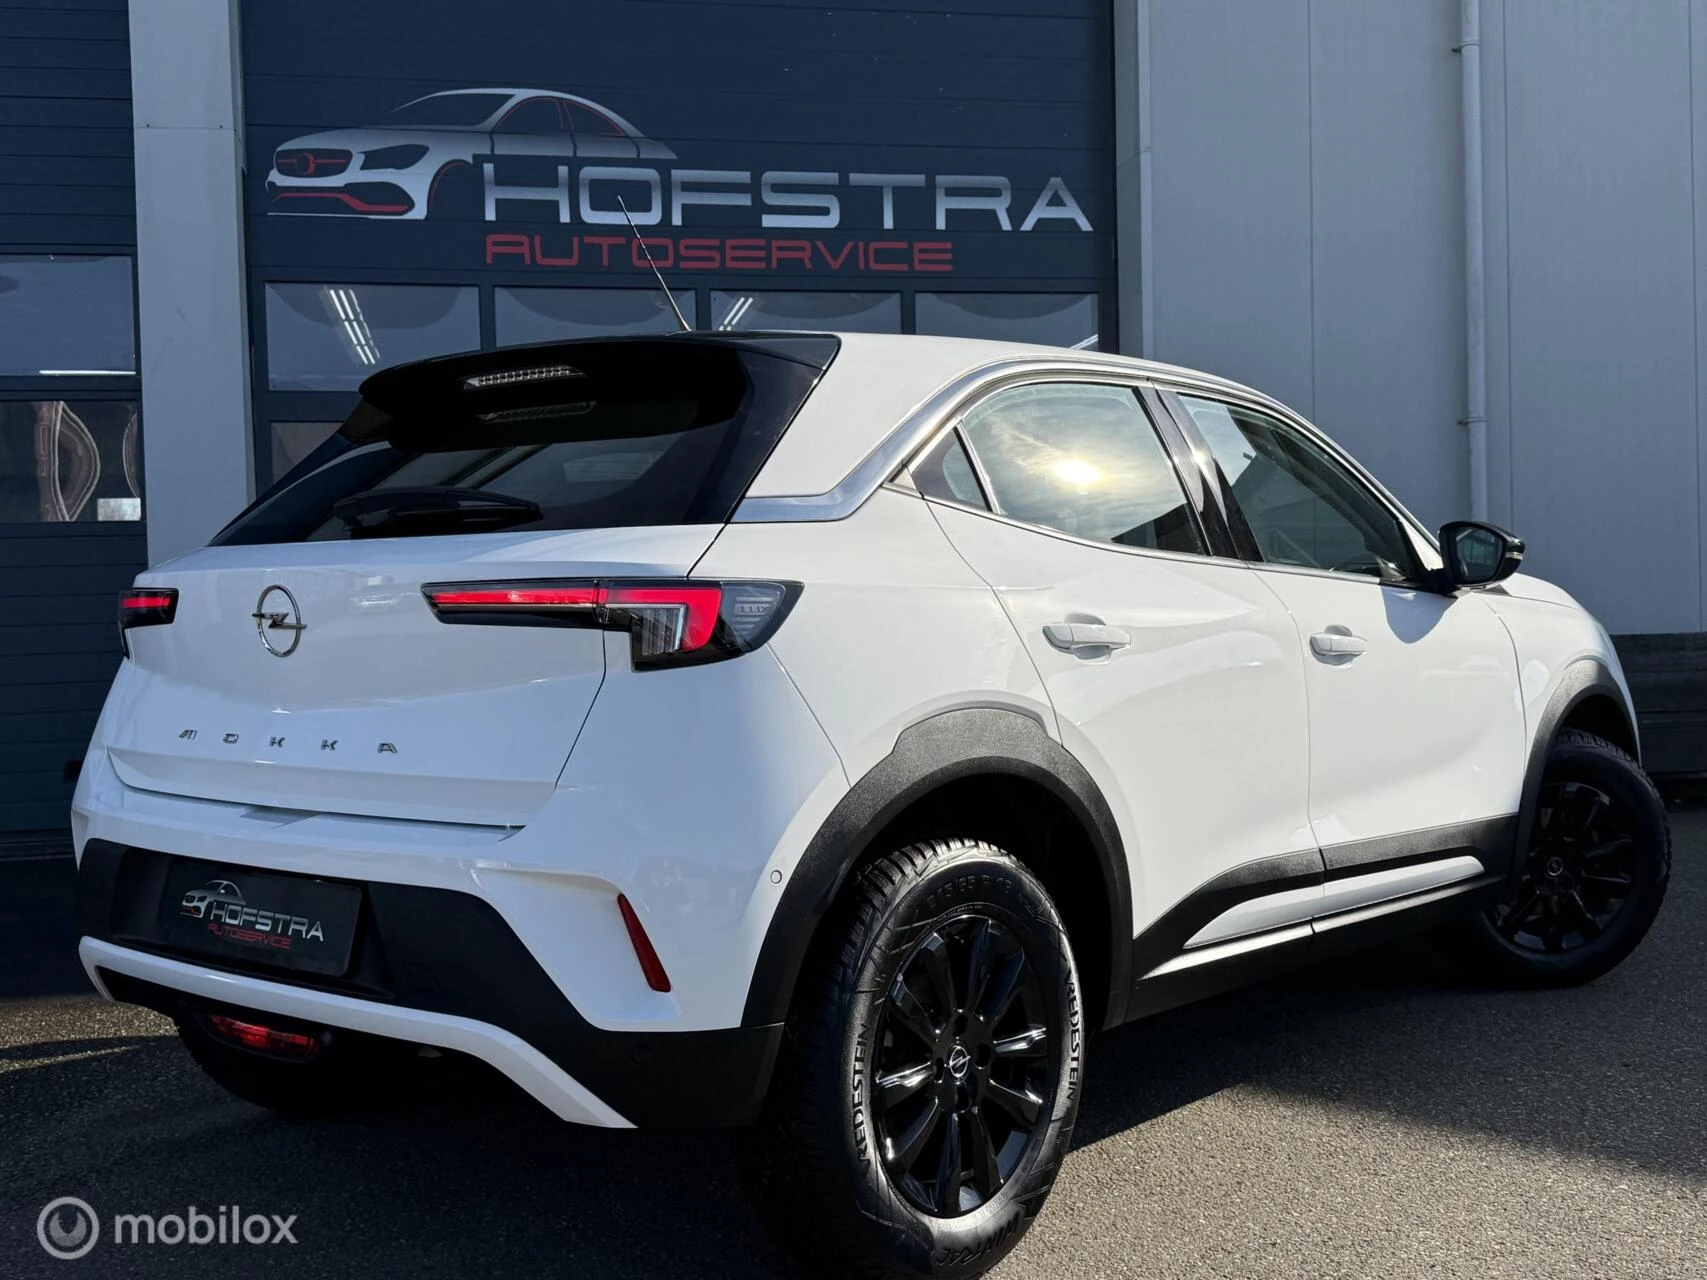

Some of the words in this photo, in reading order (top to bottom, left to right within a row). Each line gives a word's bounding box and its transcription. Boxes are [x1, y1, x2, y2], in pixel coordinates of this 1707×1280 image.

[483, 163, 1094, 231] HOFSTRA
[486, 234, 953, 271] AUTOSERVICE
[179, 729, 398, 753] MOKKA
[207, 923, 293, 950] AUTOSERVICE
[210, 901, 324, 942] HOFSTRA
[1064, 967, 1080, 1101] VREDESTEIN
[852, 1023, 872, 1178] VREDESTEIN
